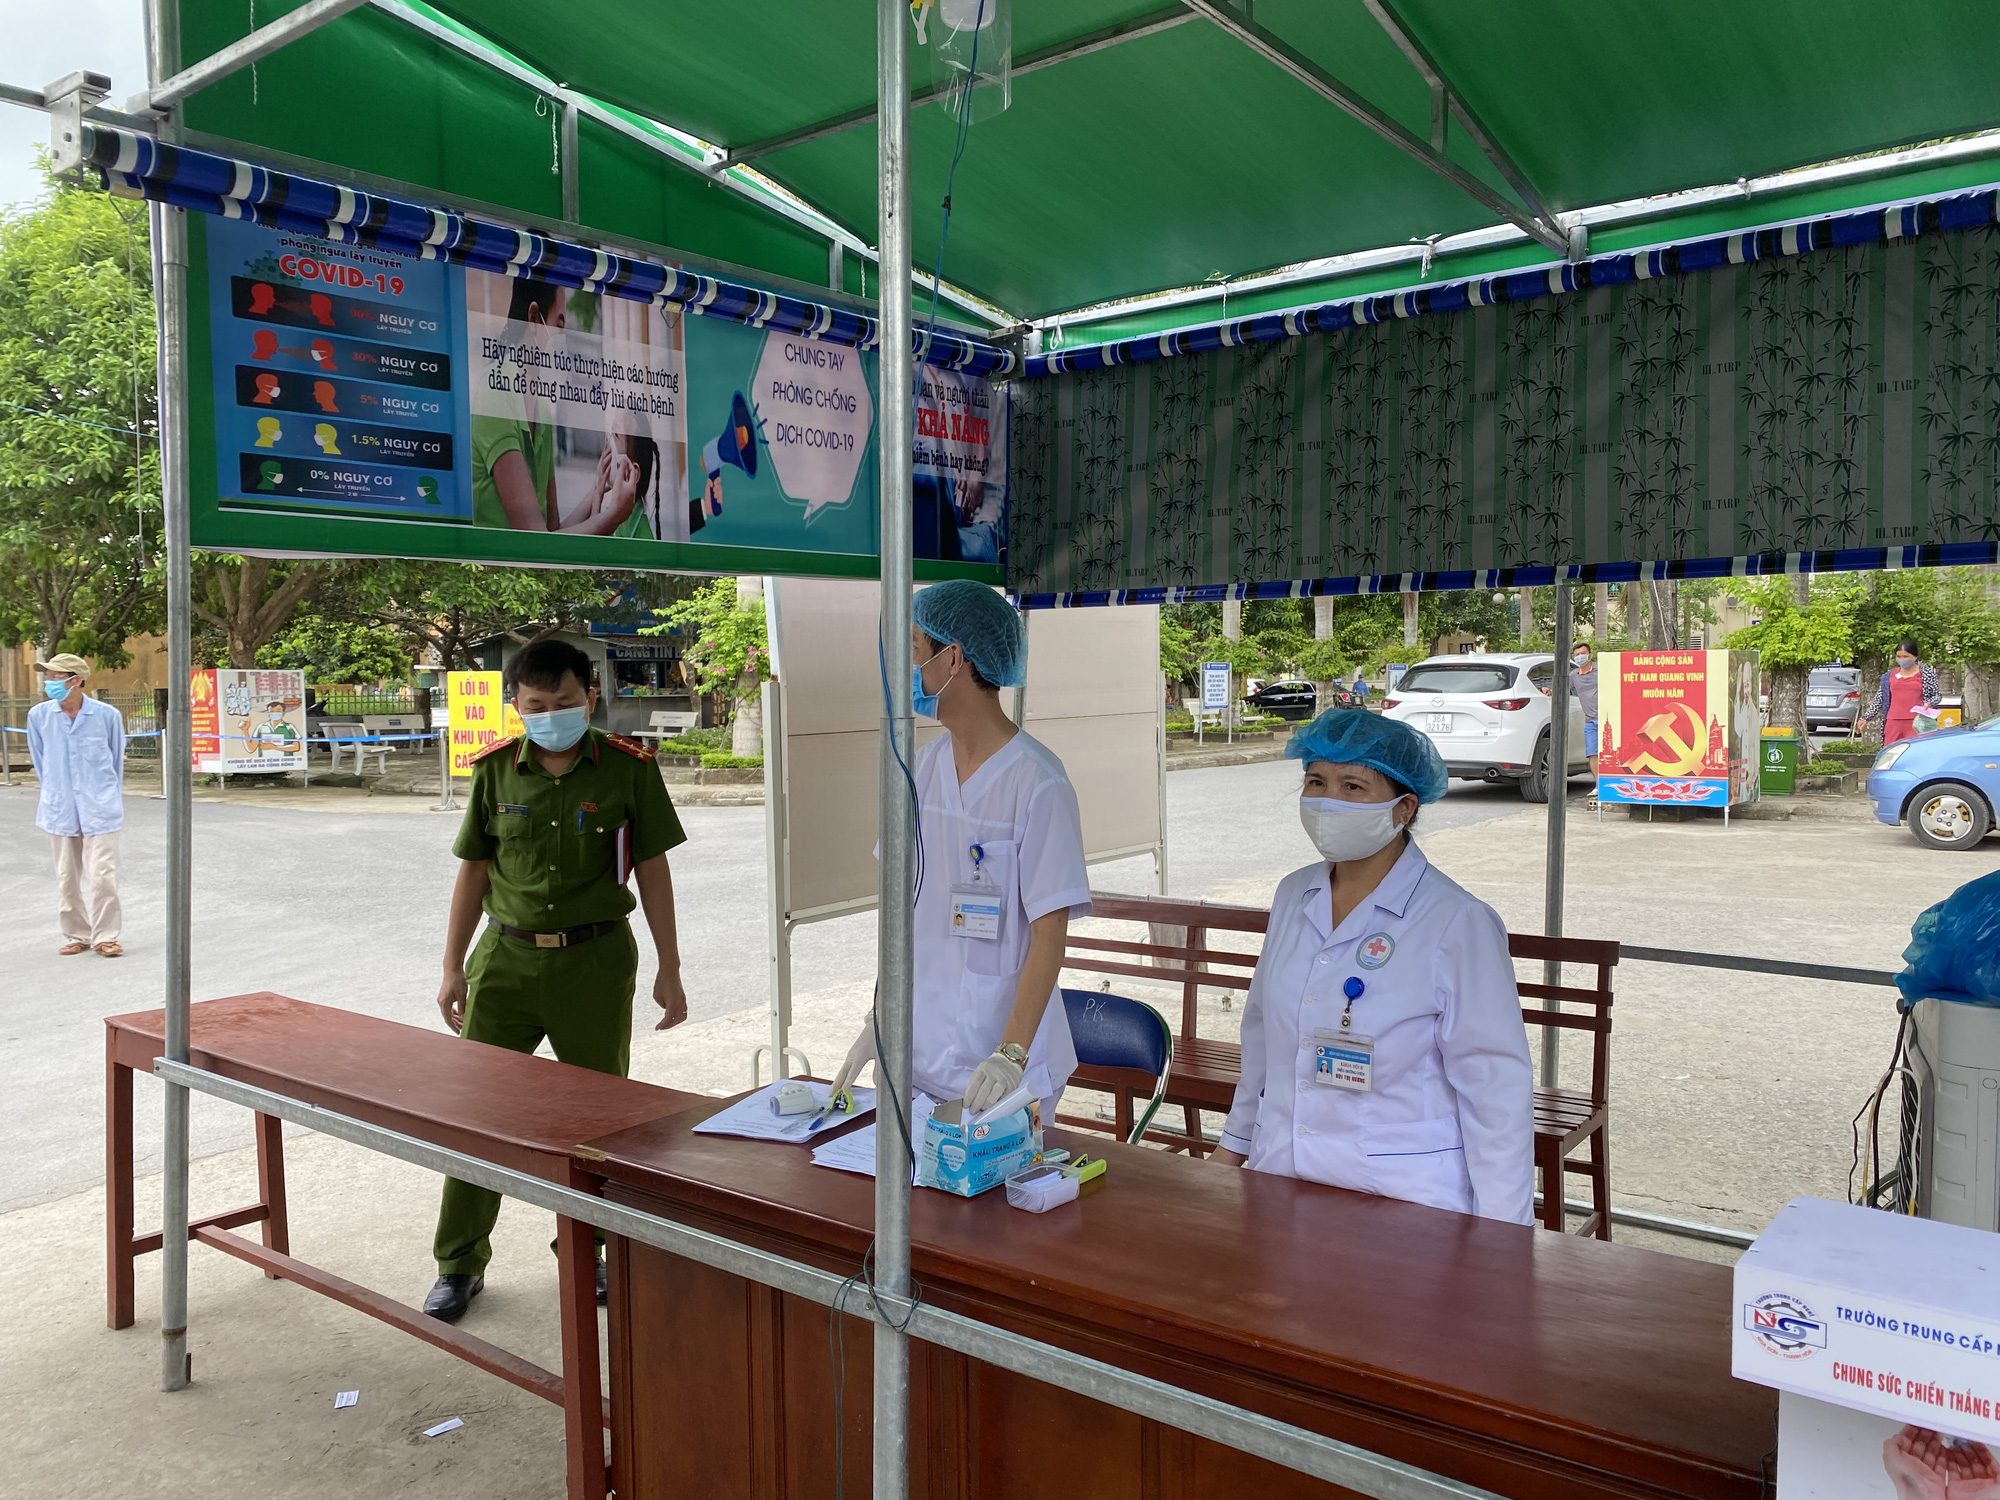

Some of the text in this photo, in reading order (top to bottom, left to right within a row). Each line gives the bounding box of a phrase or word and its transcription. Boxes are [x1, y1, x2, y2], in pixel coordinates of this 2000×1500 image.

[279, 254, 405, 296] COVID-19
[380, 313, 415, 328] NGUY
[419, 319, 437, 332] CƠ
[381, 356, 416, 371] NGUY
[420, 361, 438, 374] CƠ
[481, 337, 678, 394] Hãy nghiêm túc thực hiện các hướng
[784, 343, 845, 372] CHUNG TAY
[488, 369, 675, 417] dẫn để cùng nhau đẩy lùi dịch bệnh
[772, 381, 856, 414] PHÒNG CHỐNG
[935, 381, 945, 400] và
[946, 386, 970, 407] người
[360, 394, 440, 415] 5% NGUY CƠ
[918, 403, 990, 446] KHẢ NĂNG
[351, 434, 441, 454] 1.5% NGUY CƠ
[776, 423, 854, 452] DỊCH COVID-19
[931, 449, 949, 472] bệnh
[950, 453, 963, 473] hay
[310, 469, 393, 487] 0% NGUY CƠ
[1633, 652, 1694, 667] ĐẢNG CỘNG SẢN
[460, 676, 489, 696] LỐI ĐI
[1623, 671, 1704, 684] VIỆT NAM QUANG VINH
[1642, 688, 1684, 699] MUÔN NĂM
[464, 702, 485, 720] VÀO
[1432, 714, 1446, 723] 36A
[453, 730, 474, 745] KHU
[1083, 998, 1107, 1022] PK
[972, 1146, 990, 1158] KHẨU
[992, 1142, 1010, 1152] TRANG
[1836, 1305, 1899, 1332] TRƯỜNG
[1902, 1322, 1955, 1345] TRUNG
[1958, 1333, 1993, 1356] CẤP
[1832, 1361, 1874, 1389] CHUNG
[1877, 1371, 1902, 1396] SỨC
[1906, 1380, 1945, 1408] CHIẾN
[1948, 1388, 1990, 1419] THẮNG
